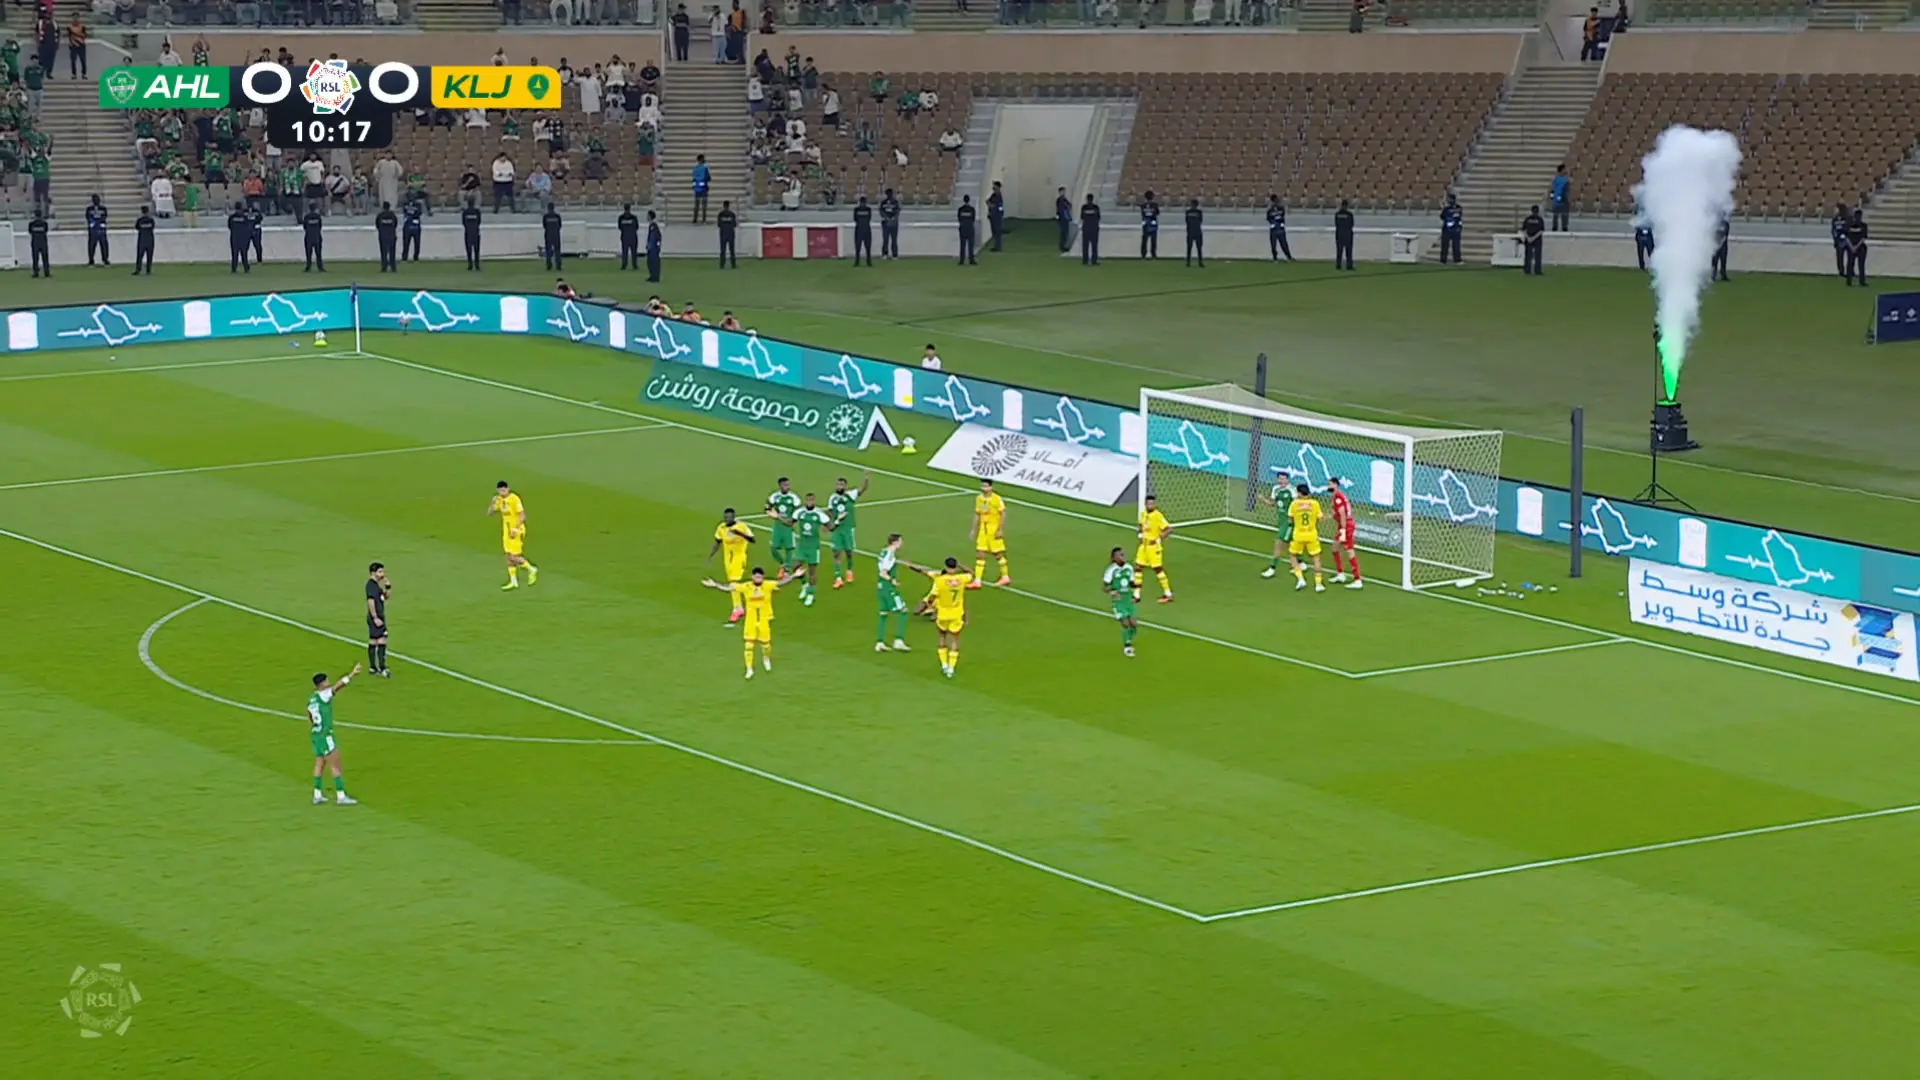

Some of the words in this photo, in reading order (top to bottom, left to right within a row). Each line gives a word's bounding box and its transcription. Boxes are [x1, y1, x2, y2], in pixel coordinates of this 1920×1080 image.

[646, 373, 721, 410] روشن
[720, 387, 820, 428] مجموعة
[1014, 468, 1085, 493] AMAALA
[1300, 512, 1310, 527] 8
[950, 589, 959, 603] 7
[1640, 569, 1725, 609] وسط
[1642, 601, 1748, 633] للتطوير
[1731, 588, 1828, 624] شركة
[1754, 622, 1831, 655] جدة
